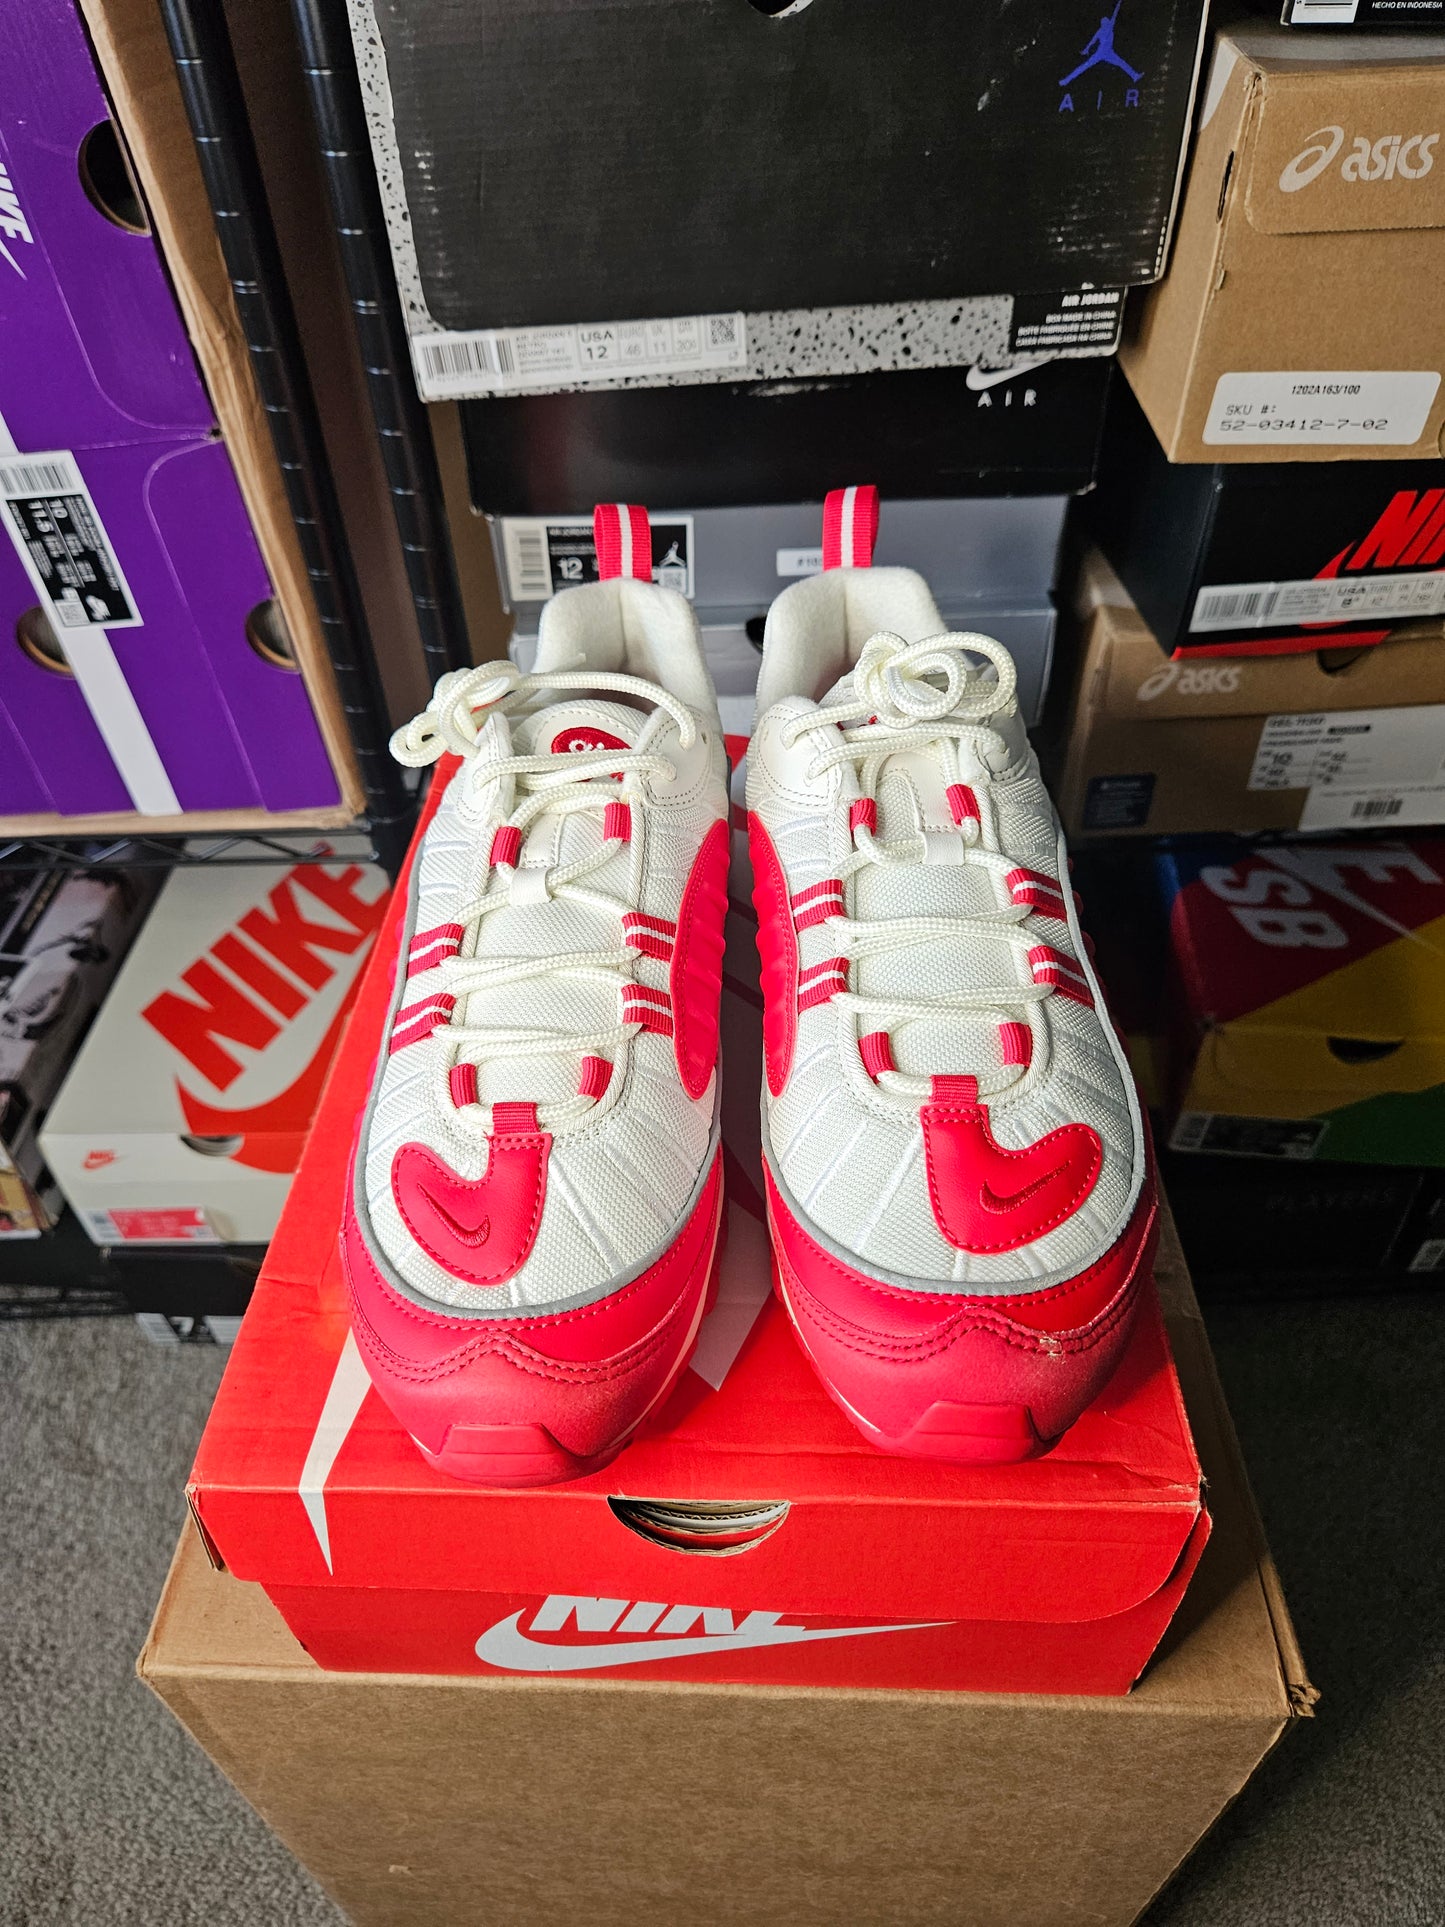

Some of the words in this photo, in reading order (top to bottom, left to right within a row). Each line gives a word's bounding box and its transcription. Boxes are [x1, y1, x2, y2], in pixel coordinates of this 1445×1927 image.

[1371, 1, 1396, 9] HECHO
[1396, 1, 1407, 9] EN
[1407, 1, 1443, 9] INDONESIA
[1058, 88, 1140, 112] AIR
[1061, 294, 1080, 307] AIR
[1080, 292, 1120, 306] JORDAN
[1062, 312, 1083, 323] MADE
[1083, 311, 1092, 321] IN
[1092, 310, 1117, 320] CHINA
[580, 330, 614, 343] USA
[586, 345, 608, 360] 12
[1292, 384, 1361, 395] 1202A163/100
[977, 388, 1037, 408] AIR
[1225, 404, 1252, 416] SKU
[1219, 419, 1388, 431] 52-03412-7-02
[557, 556, 583, 579] 12
[141, 841, 391, 1093] NIKE
